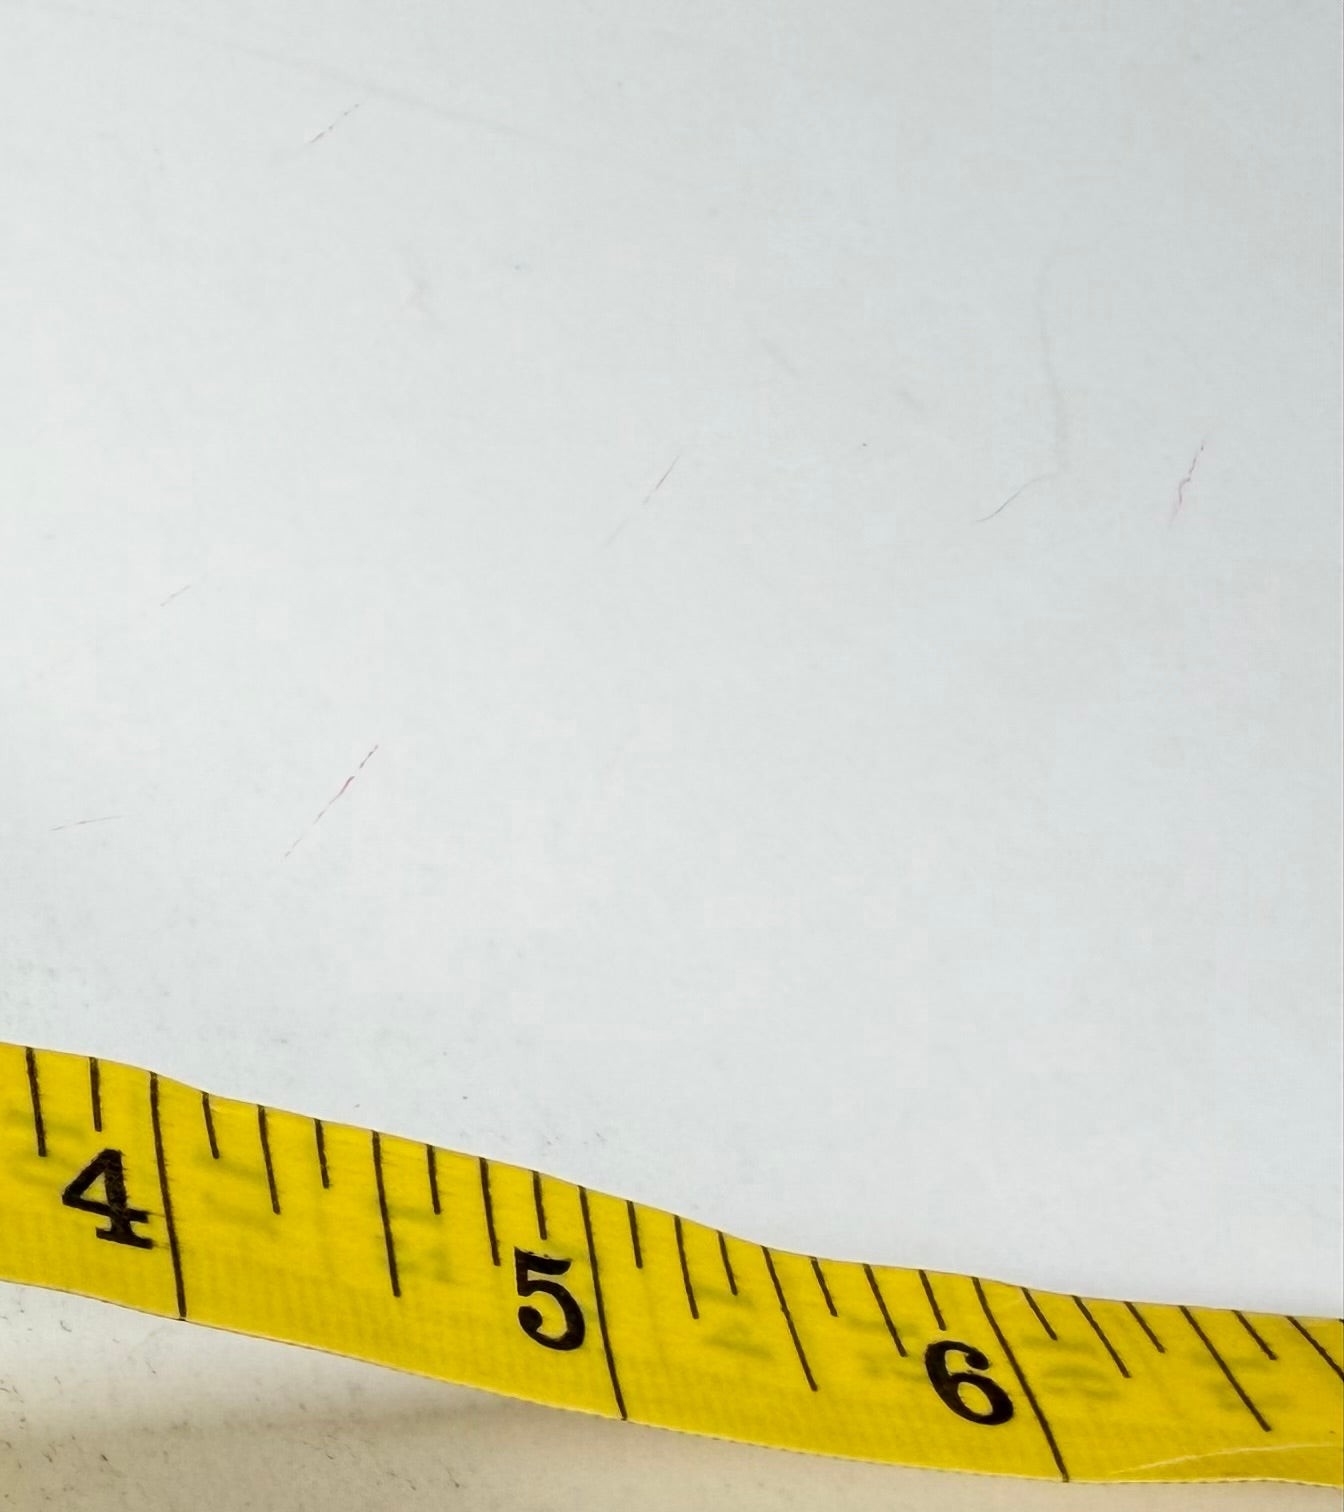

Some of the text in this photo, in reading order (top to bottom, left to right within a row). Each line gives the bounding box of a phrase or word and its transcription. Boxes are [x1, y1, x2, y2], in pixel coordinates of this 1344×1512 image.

[62, 1148, 154, 1249] 4
[514, 1247, 586, 1350] 5
[924, 1341, 1014, 1426] 6
